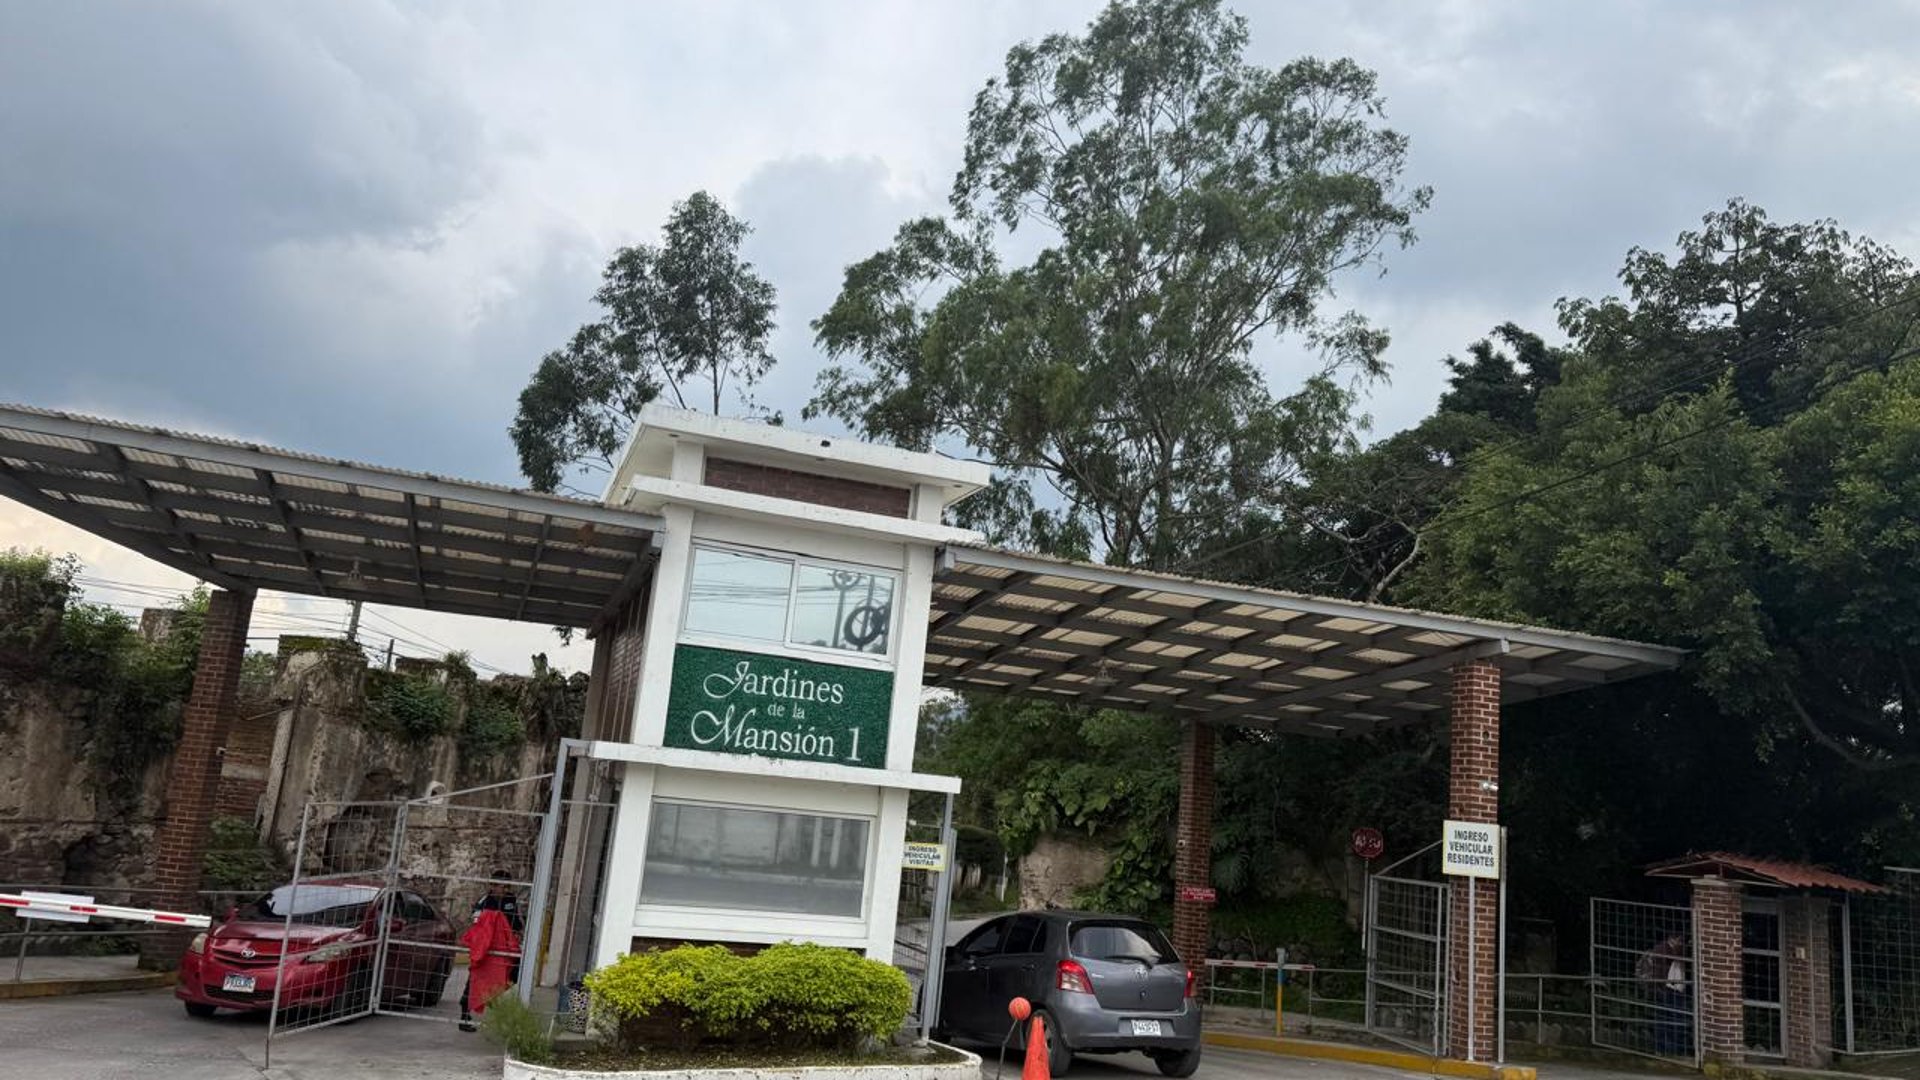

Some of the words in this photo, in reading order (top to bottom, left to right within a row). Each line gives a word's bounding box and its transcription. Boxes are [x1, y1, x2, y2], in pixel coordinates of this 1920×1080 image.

[703, 661, 844, 704] Jardines
[767, 702, 786, 717] de
[792, 703, 805, 719] la
[691, 704, 835, 757] Mansión
[846, 727, 862, 761] 1
[1454, 830, 1489, 842] INGRESO
[1449, 841, 1493, 855] VEHICULAR
[1447, 853, 1494, 867] RESIDENTES
